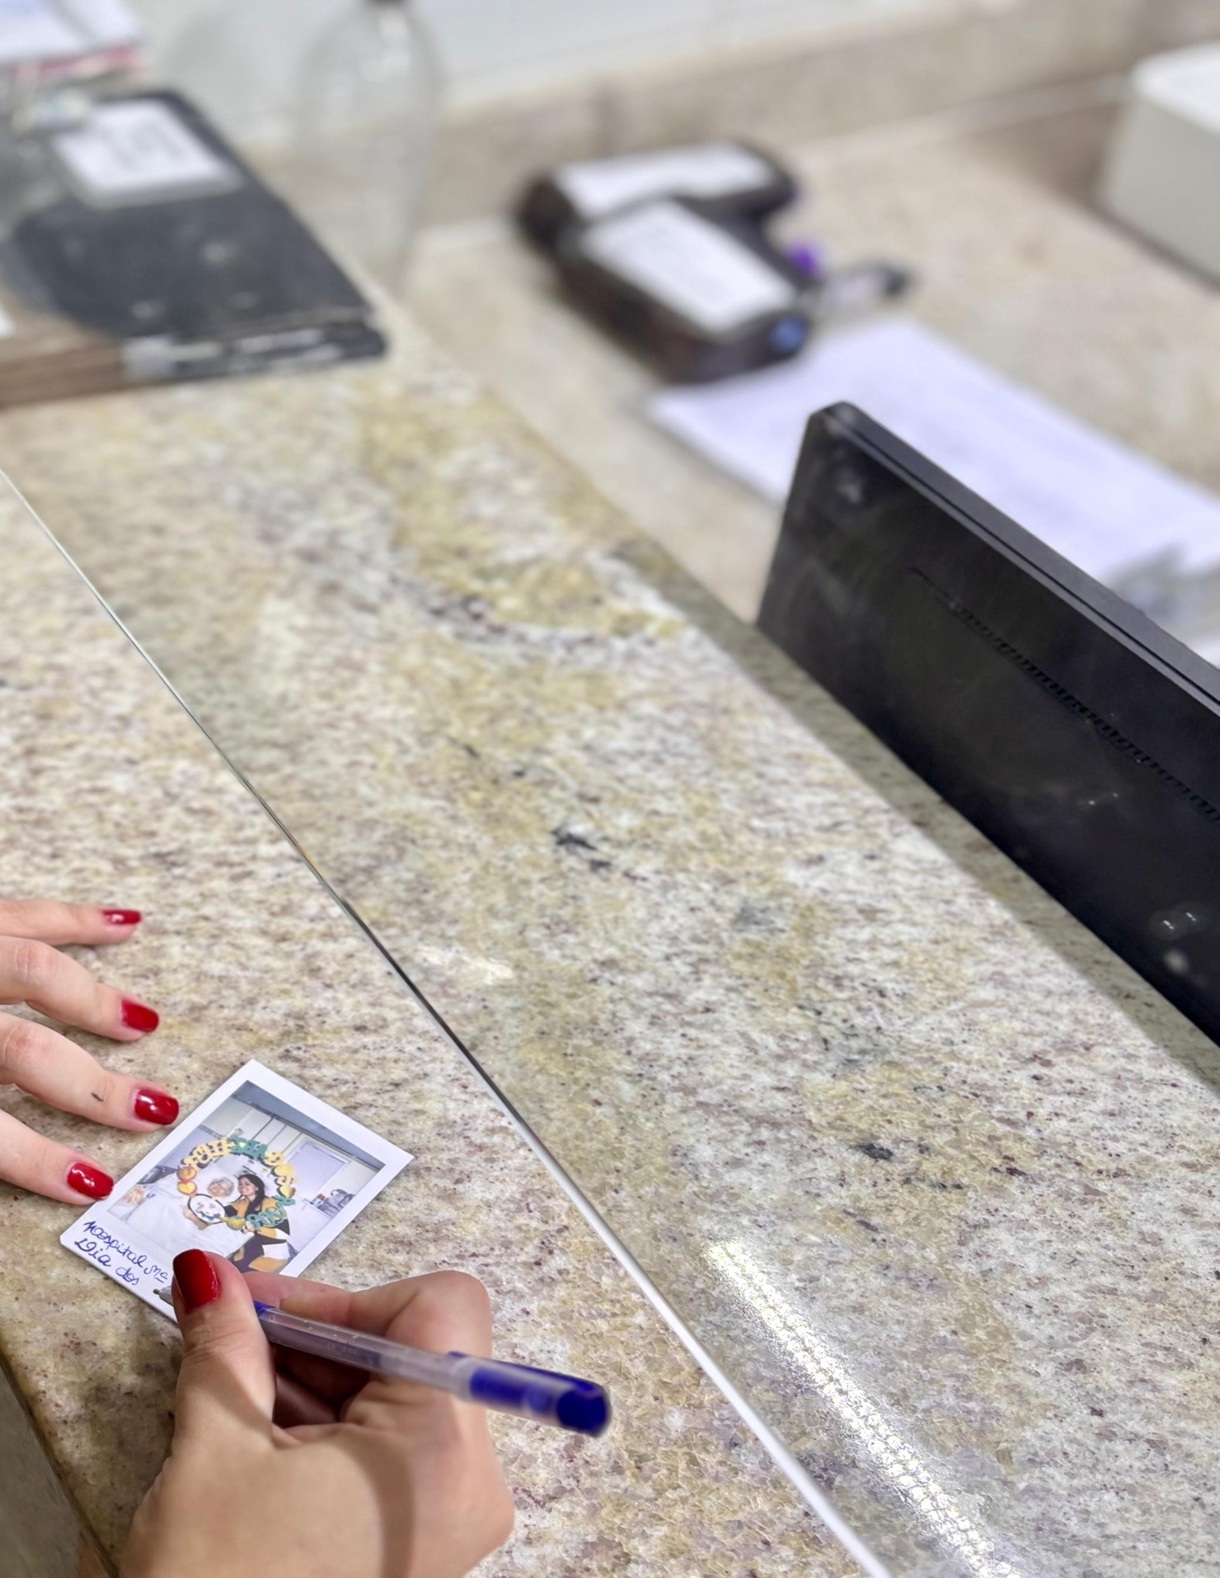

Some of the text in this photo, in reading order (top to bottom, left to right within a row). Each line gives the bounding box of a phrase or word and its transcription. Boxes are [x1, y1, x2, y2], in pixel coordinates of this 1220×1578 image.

[74, 1237, 140, 1286] Dia dos
[83, 1220, 148, 1268] Hospital
